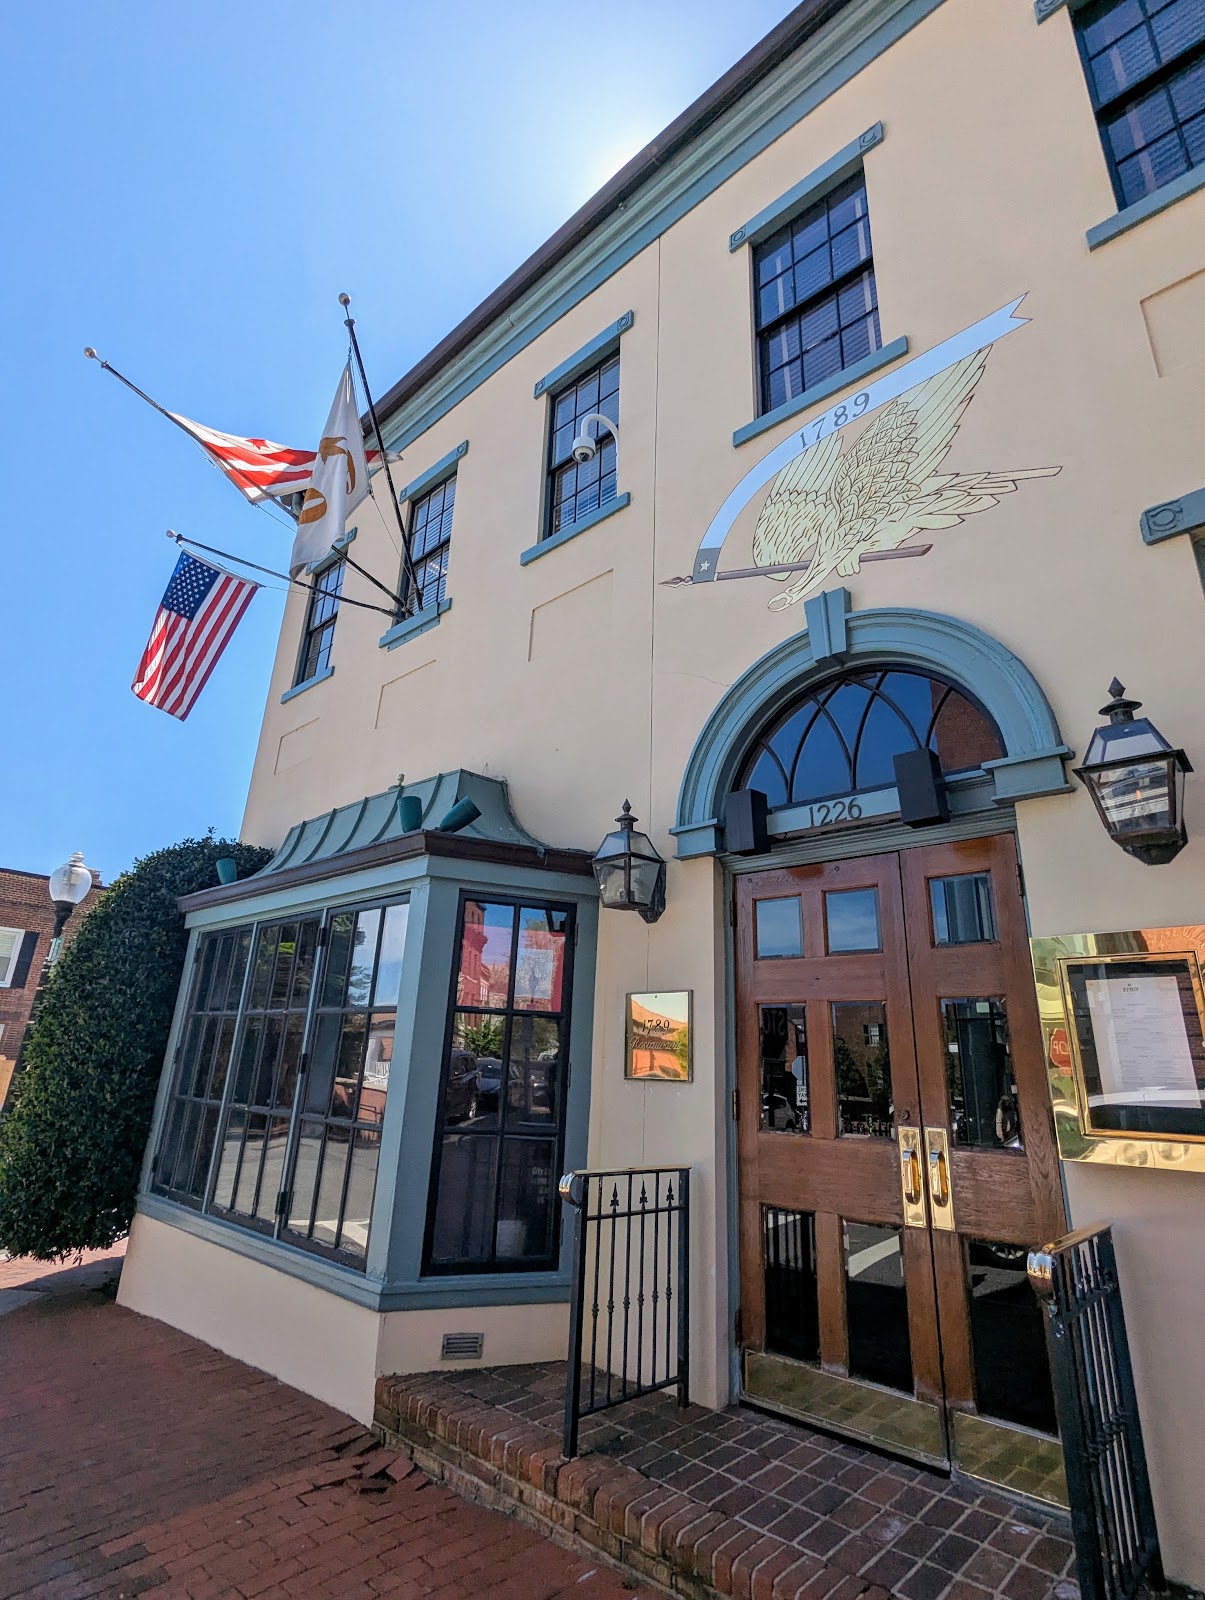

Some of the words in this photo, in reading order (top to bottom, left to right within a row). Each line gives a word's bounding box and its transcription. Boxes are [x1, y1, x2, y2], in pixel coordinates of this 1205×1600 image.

[799, 392, 870, 449] 1789
[809, 797, 862, 828] 1226
[641, 1018, 670, 1038] 1789
[629, 1035, 683, 1050] Restaurant
